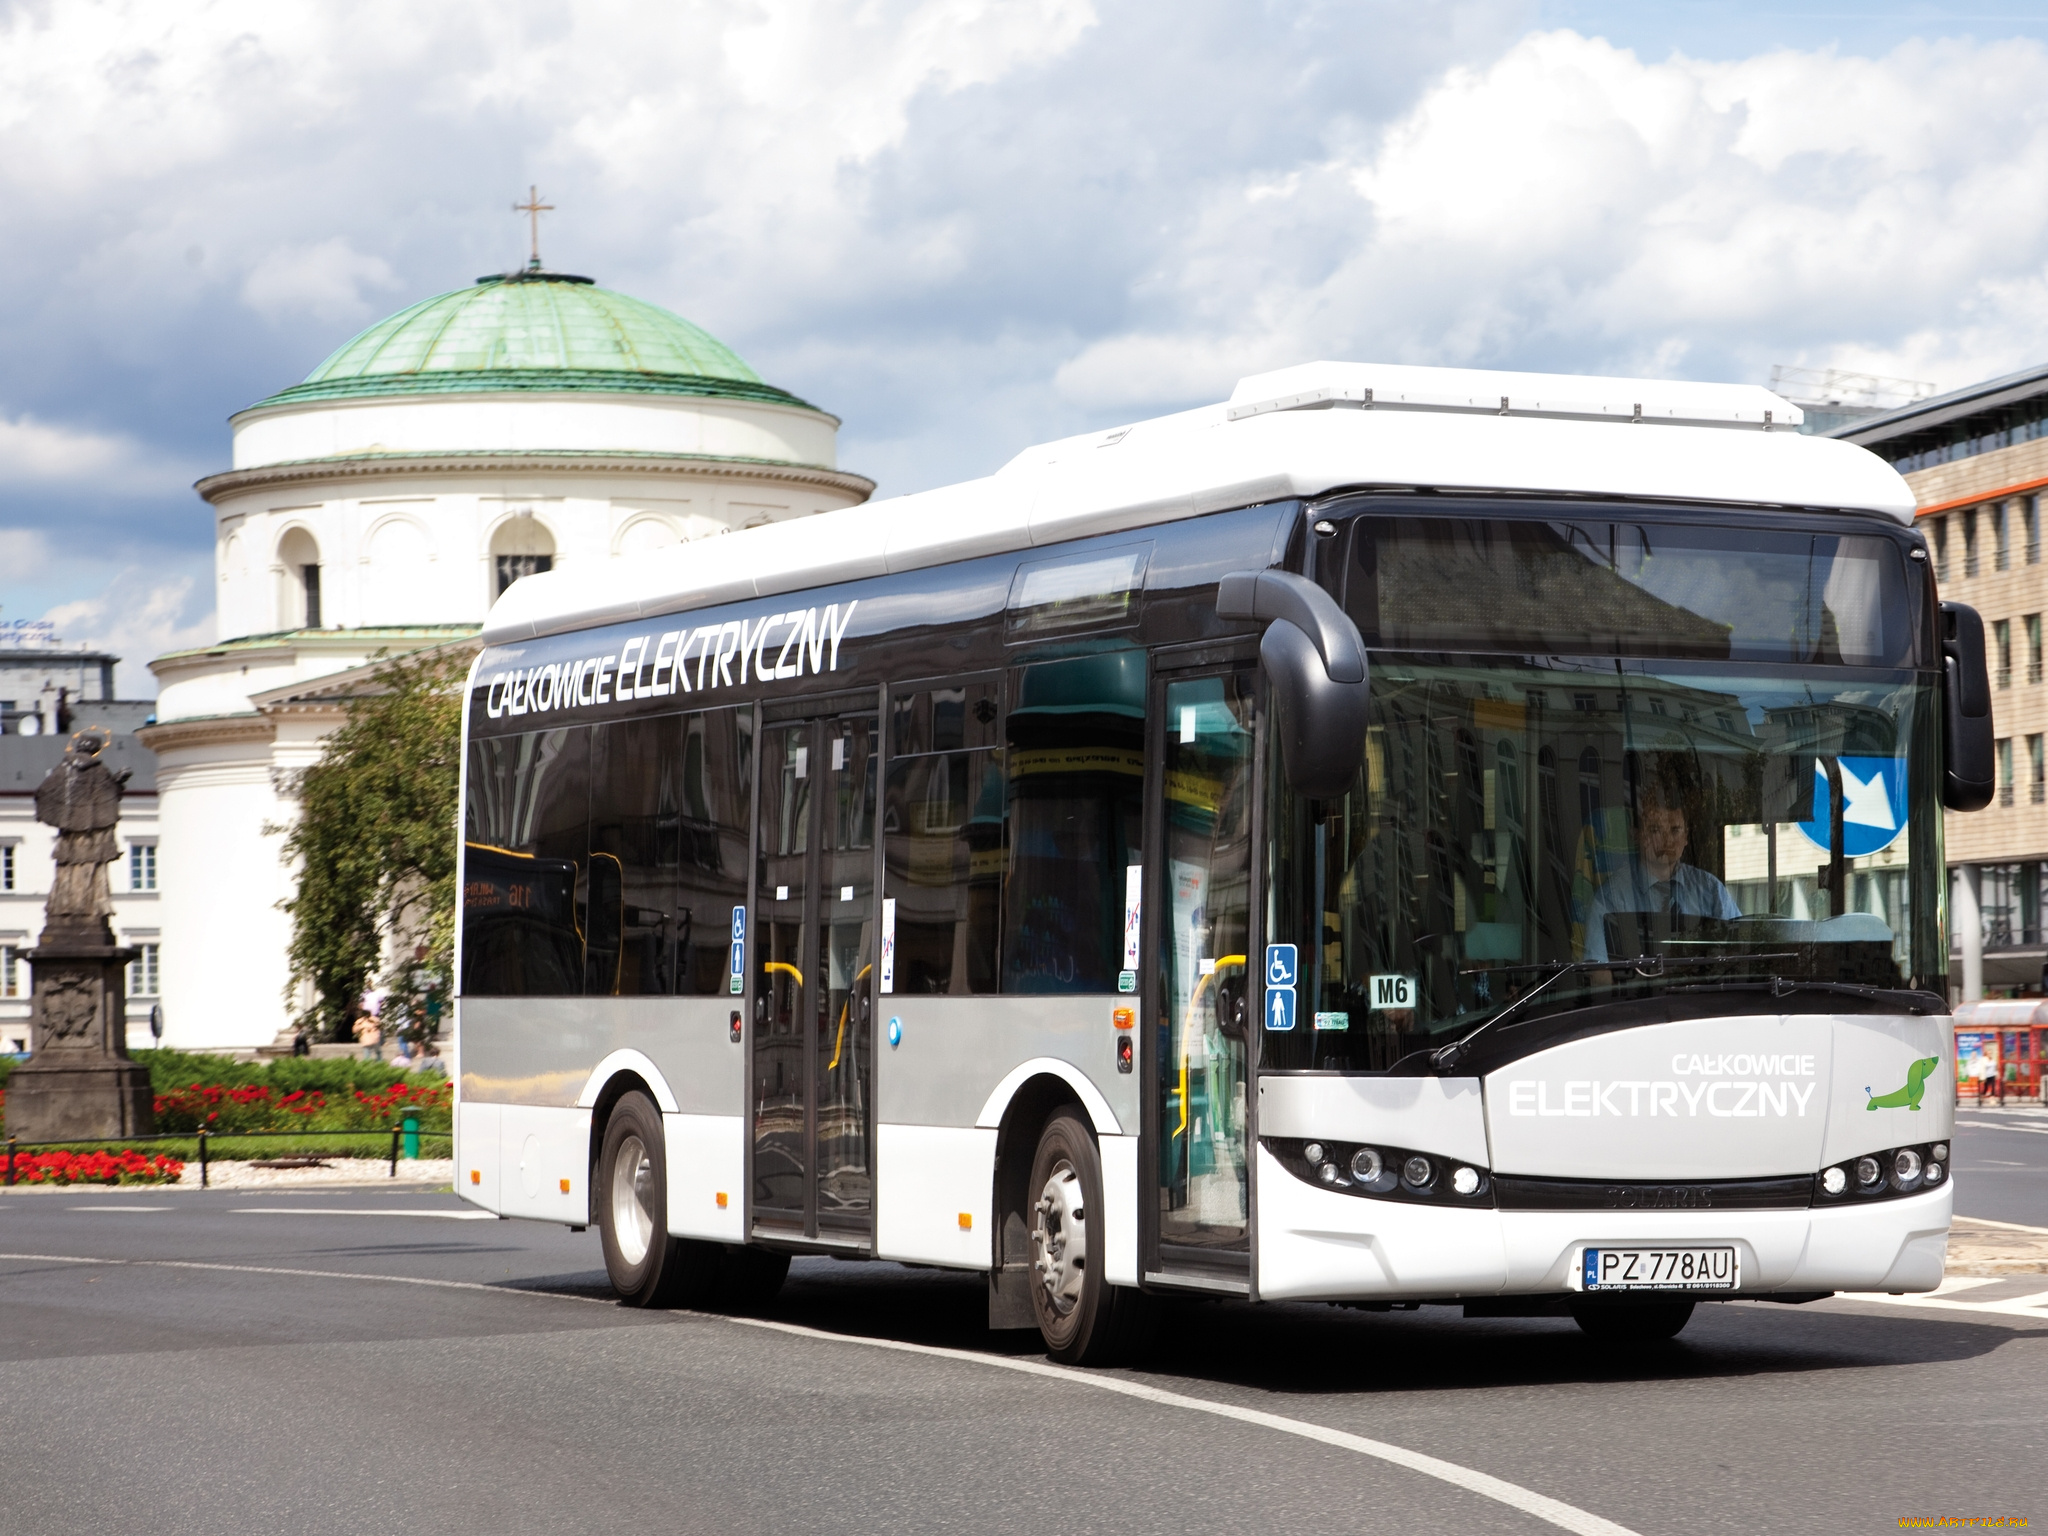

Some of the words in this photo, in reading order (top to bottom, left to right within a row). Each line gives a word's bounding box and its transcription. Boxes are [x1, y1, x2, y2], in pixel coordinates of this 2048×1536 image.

[487, 655, 618, 719] CAŁKOWICIE
[615, 600, 858, 702] ELEKTRYCZNY
[1378, 977, 1408, 1004] M6
[1672, 1054, 1815, 1076] CAŁKOWICIE
[1508, 1080, 1816, 1118] ELEKTRYCZNY
[1604, 1186, 1713, 1208] SOLARIS
[1587, 1270, 1597, 1279] PL
[1602, 1253, 1640, 1280] PZ
[1650, 1252, 1728, 1280] 778AU
